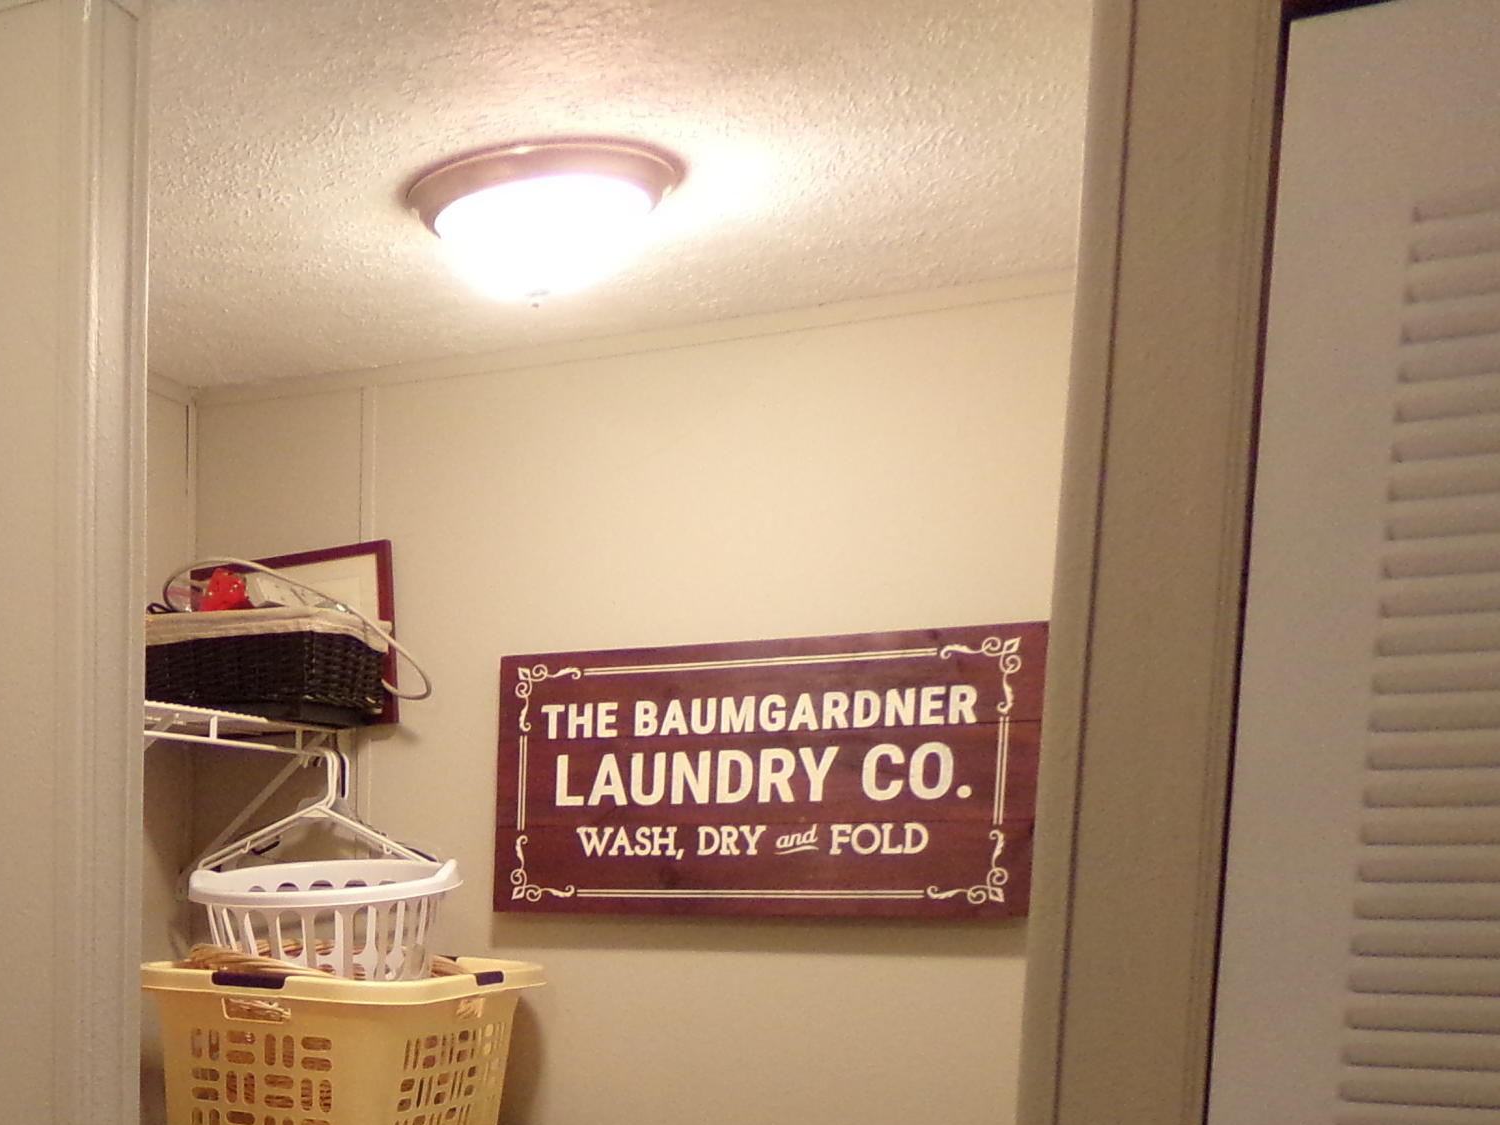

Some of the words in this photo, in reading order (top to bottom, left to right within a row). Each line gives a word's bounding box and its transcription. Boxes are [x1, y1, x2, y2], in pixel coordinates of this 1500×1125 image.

[541, 702, 618, 739] THE
[634, 685, 978, 737] BAUMGARDNER
[555, 746, 840, 807] LAUNDRY
[861, 741, 972, 802] CO.
[576, 825, 685, 861] WASH,
[697, 824, 767, 856] DRY
[775, 823, 819, 855] and
[830, 822, 929, 855] FOLD
